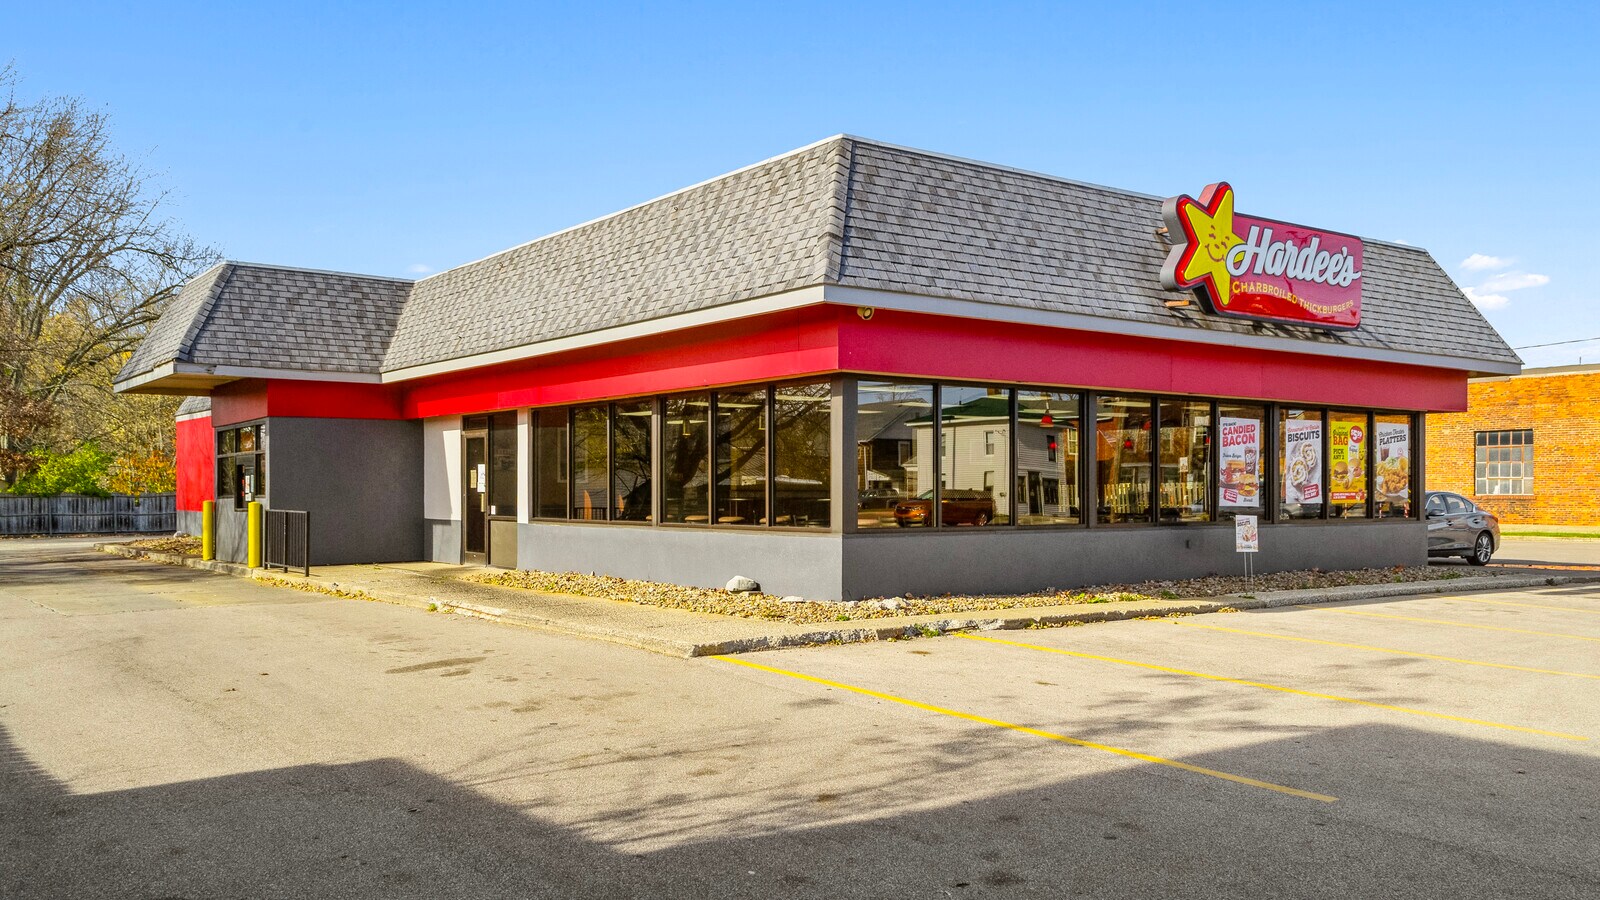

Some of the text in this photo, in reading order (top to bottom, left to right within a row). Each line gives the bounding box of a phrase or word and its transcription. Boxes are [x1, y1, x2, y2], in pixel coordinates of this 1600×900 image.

[1226, 225, 1361, 287] Hardee's
[1232, 281, 1354, 314] CHARBROILED THICKBURGERS
[1222, 424, 1256, 436] CANDIED
[1287, 430, 1320, 442] BISCUITS
[1222, 433, 1256, 447] BACON
[1333, 436, 1349, 446] BAG
[1379, 434, 1407, 446] PLATTERS
